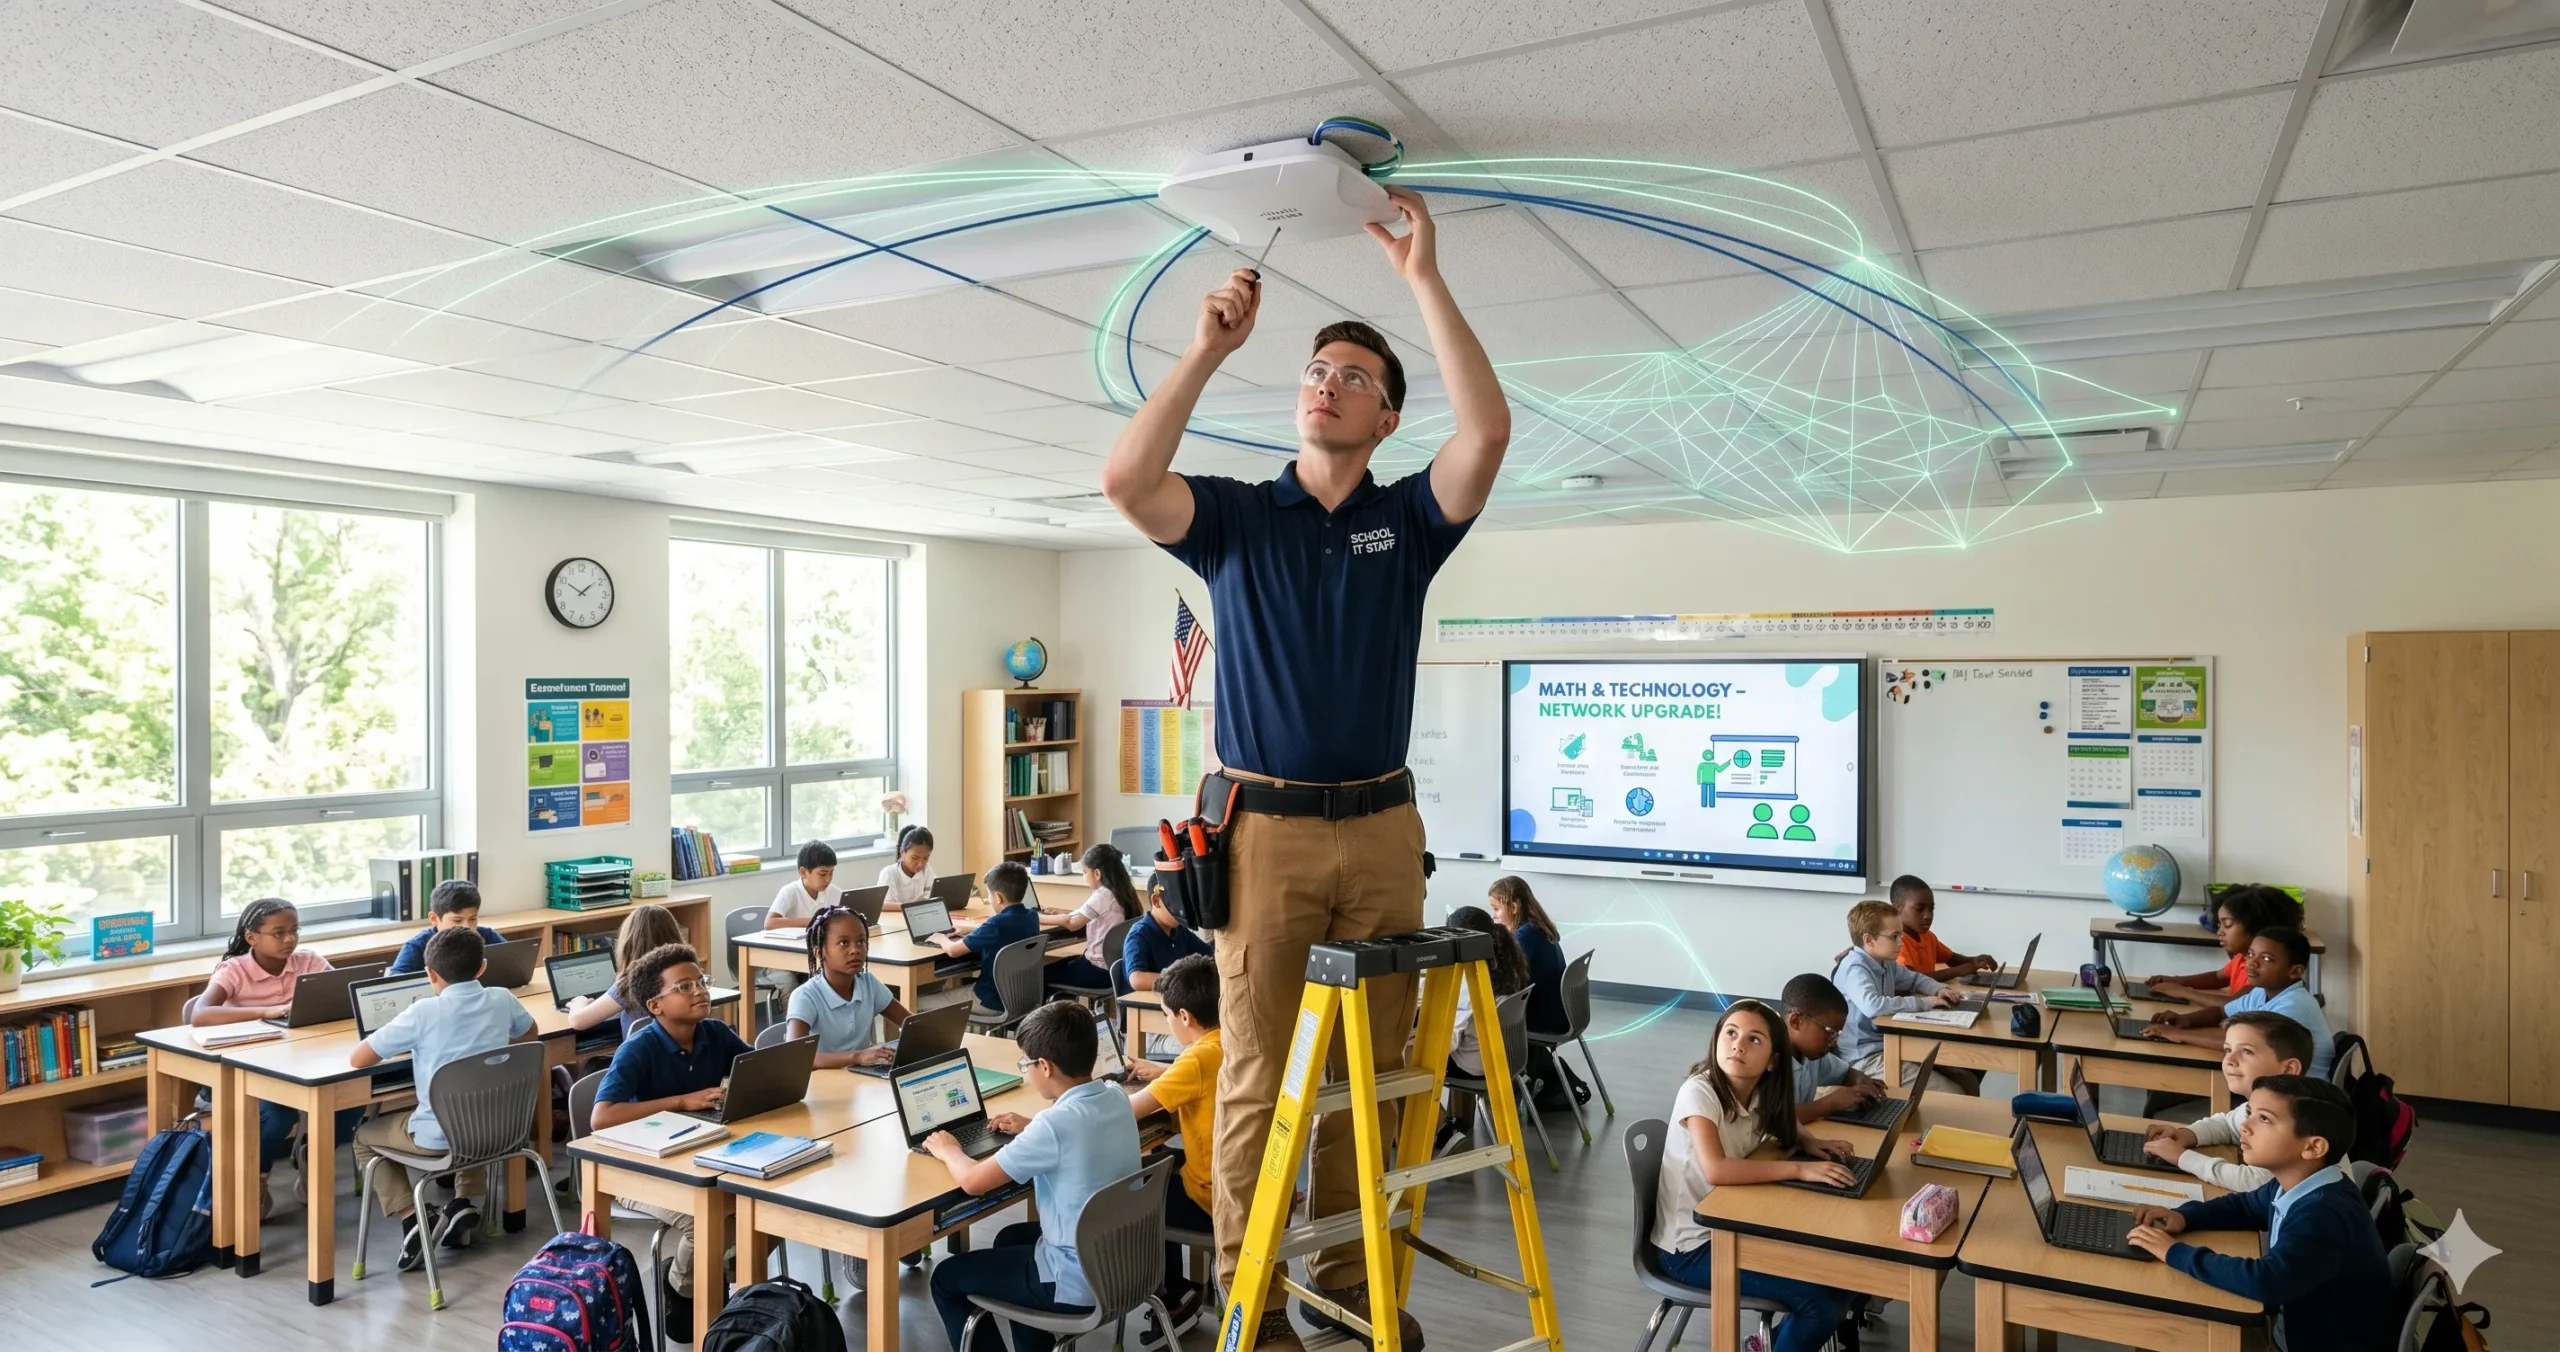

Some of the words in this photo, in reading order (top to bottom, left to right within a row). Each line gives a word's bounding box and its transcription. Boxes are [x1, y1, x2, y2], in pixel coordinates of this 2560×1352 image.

[1350, 527, 1394, 544] SCHOOL
[1352, 544, 1363, 555] IT
[1365, 539, 1395, 553] STAFF
[1539, 682, 1587, 697] MATH
[1592, 682, 1605, 697] &
[1609, 682, 1732, 698] TECHNOLOGY
[1539, 703, 1625, 718] NETWORK
[1632, 704, 1721, 719] UPGRADE!
